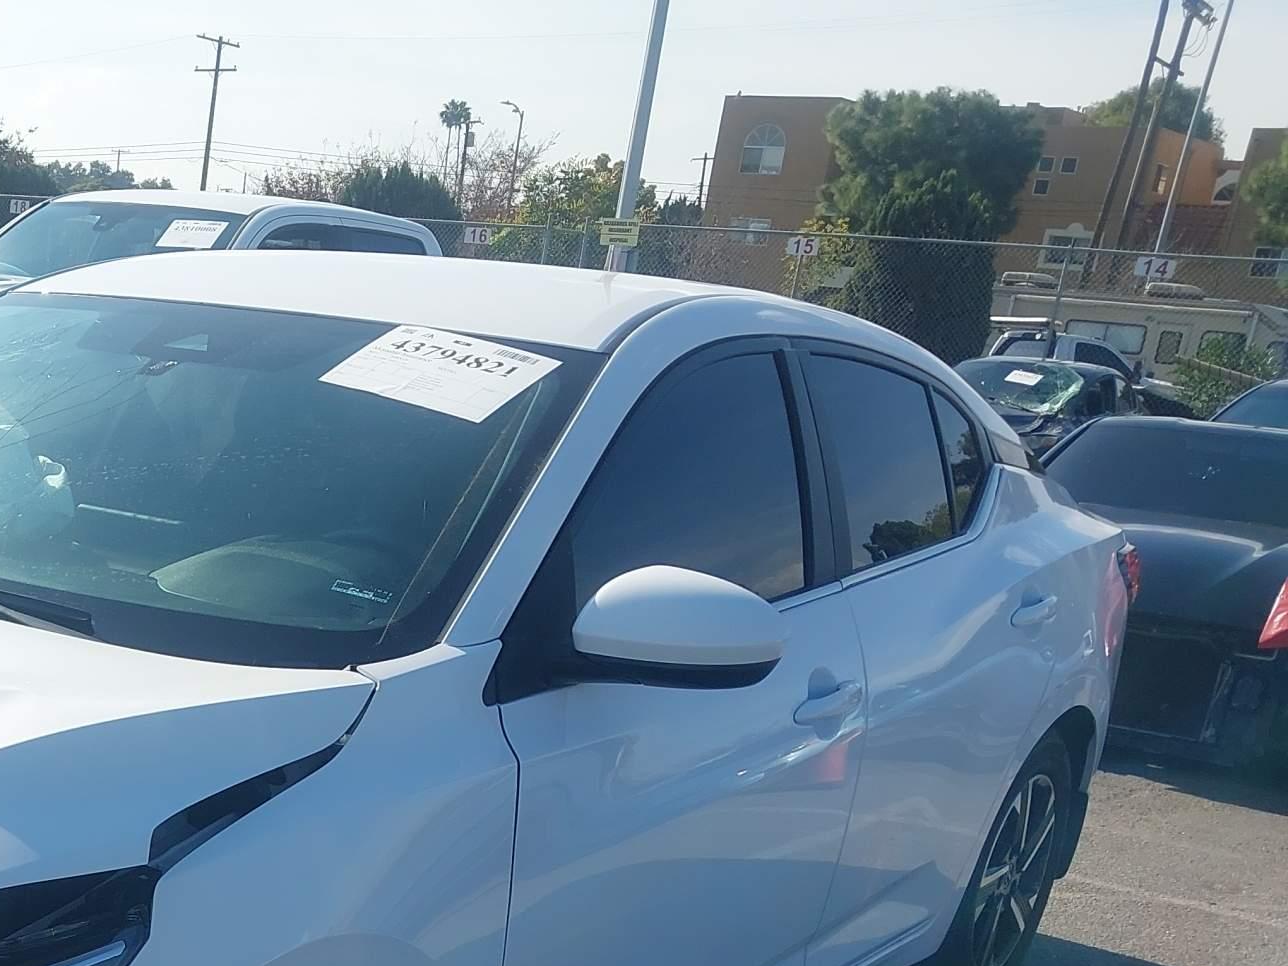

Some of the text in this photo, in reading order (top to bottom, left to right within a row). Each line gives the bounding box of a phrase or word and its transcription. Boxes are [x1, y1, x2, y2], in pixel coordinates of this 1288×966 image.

[470, 228, 488, 243] 16
[793, 238, 814, 254] 15
[1144, 258, 1169, 276] 14
[391, 339, 520, 378] 43794821
